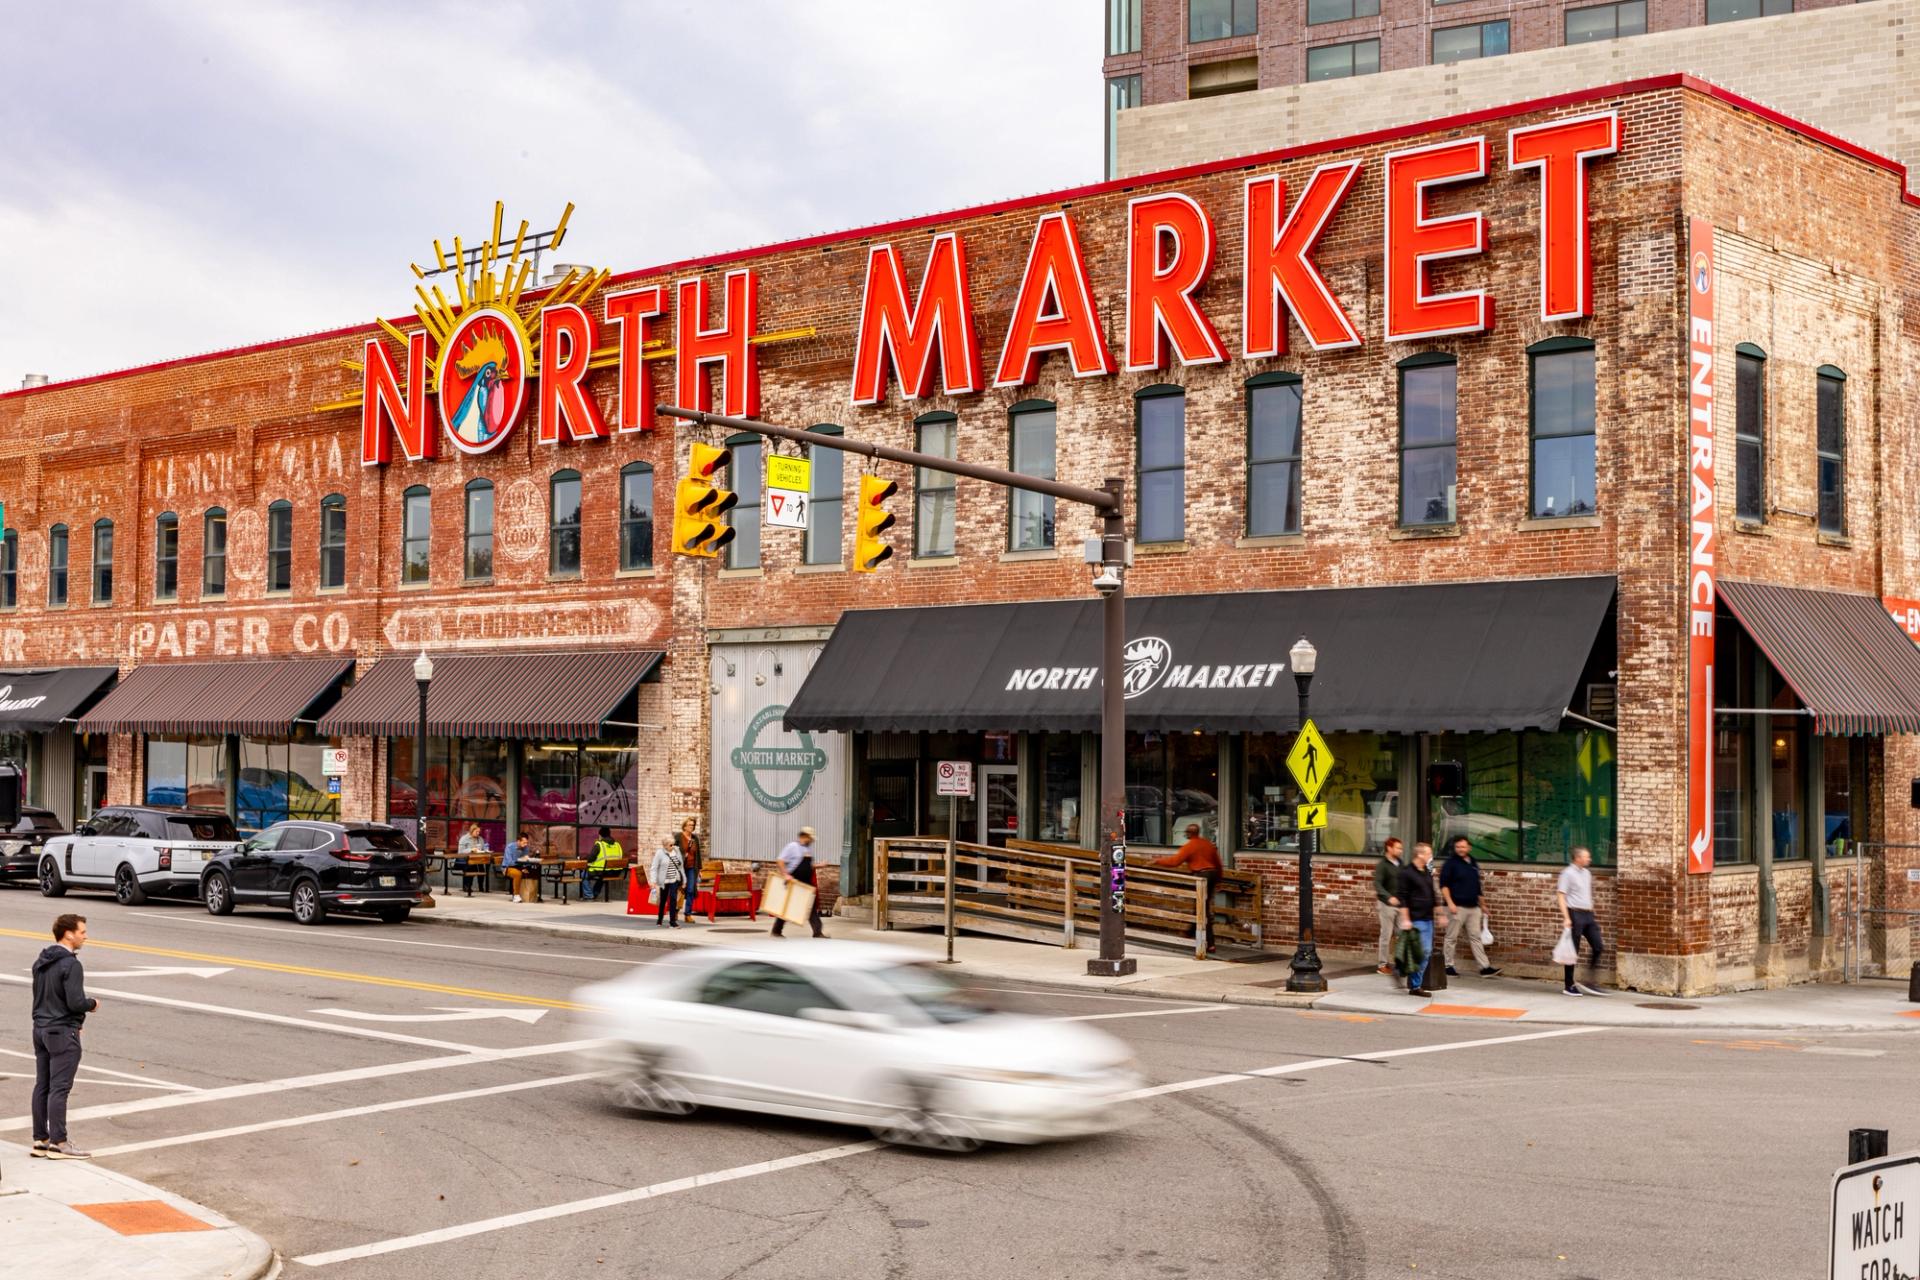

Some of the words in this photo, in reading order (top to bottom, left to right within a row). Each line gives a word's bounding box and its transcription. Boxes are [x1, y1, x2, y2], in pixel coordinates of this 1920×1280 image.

[850, 109, 1621, 407] MARKET
[777, 462, 802, 474] TURNING
[1690, 315, 1714, 638] ENTRANCE
[776, 473, 802, 485] VEHICLES
[786, 503, 794, 512] TO
[129, 616, 270, 657] PAPER
[292, 611, 358, 653] CO.
[1005, 667, 1099, 690] NORTH
[1162, 663, 1286, 689] MARKET
[740, 751, 773, 765] NORTH
[776, 752, 816, 766] MARKET
[787, 789, 802, 805] OHIO
[1852, 1201, 1904, 1251] WATCH
